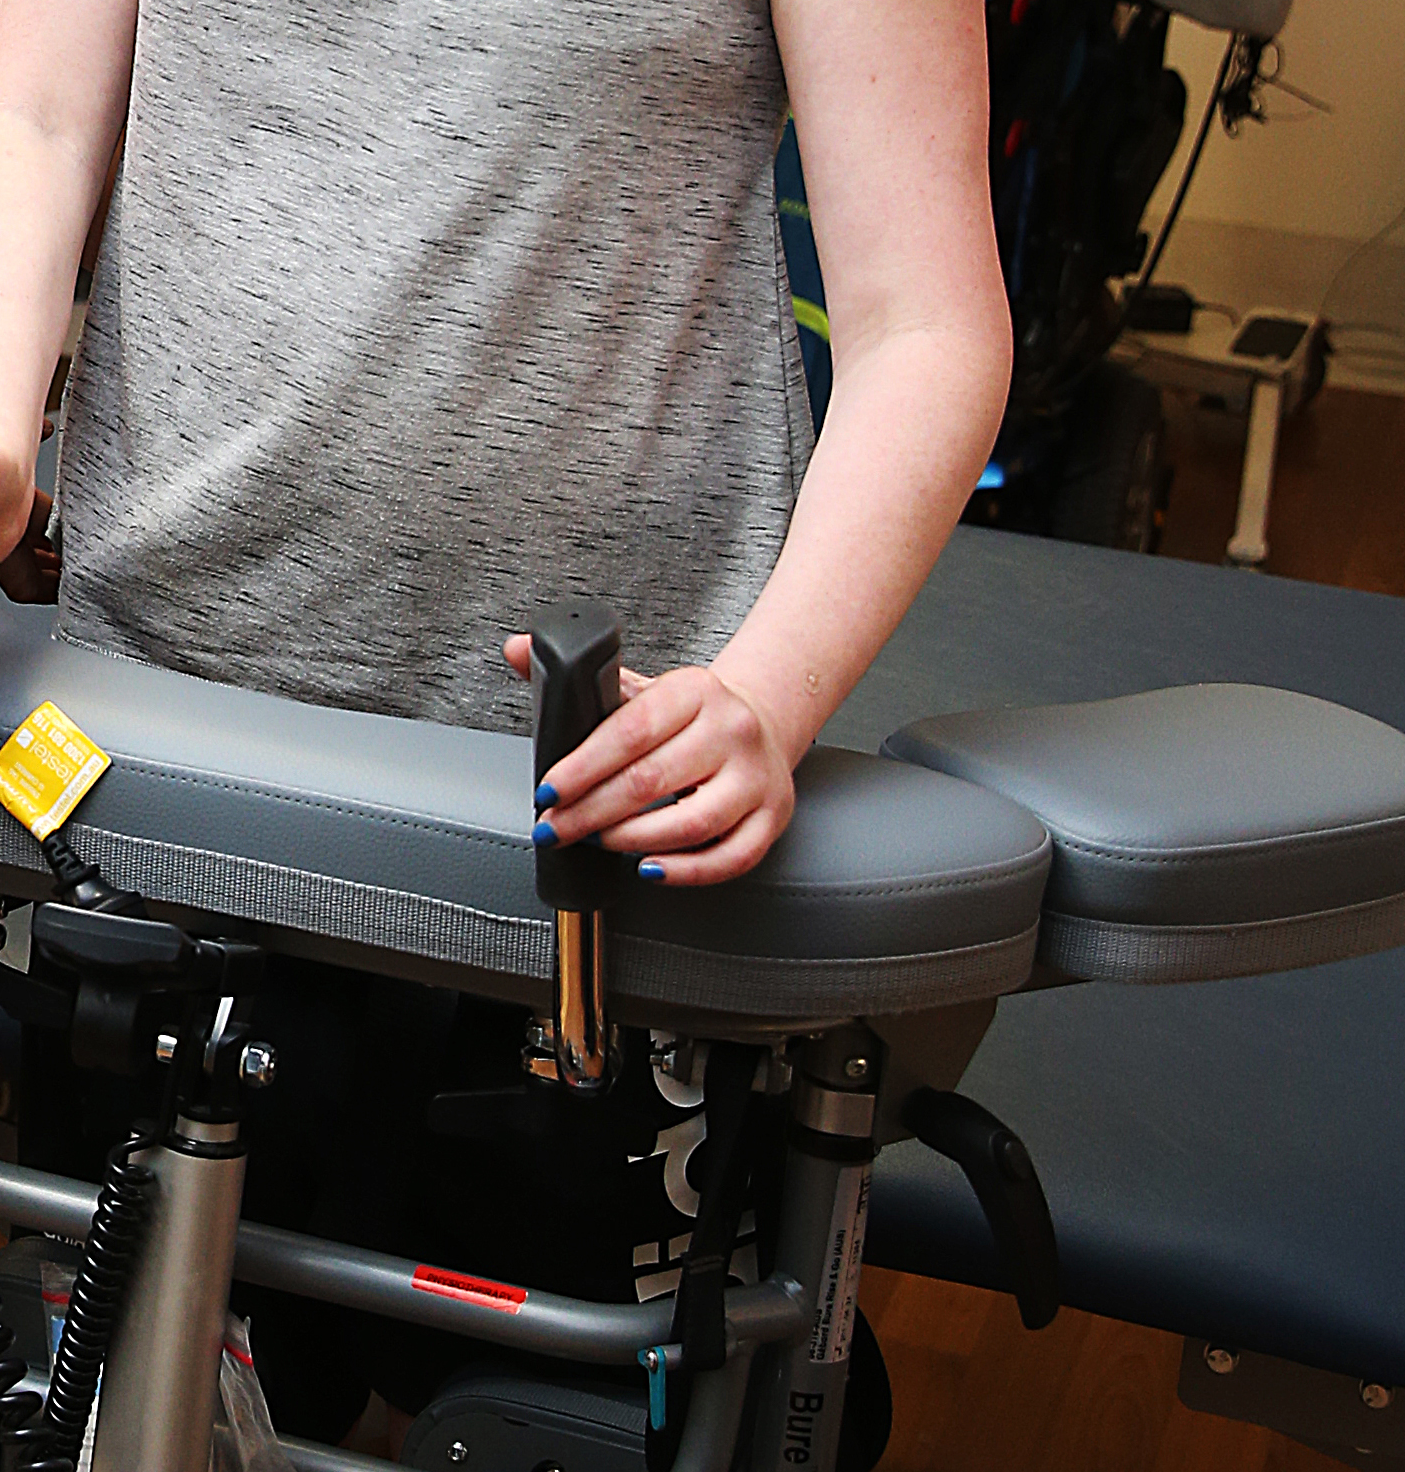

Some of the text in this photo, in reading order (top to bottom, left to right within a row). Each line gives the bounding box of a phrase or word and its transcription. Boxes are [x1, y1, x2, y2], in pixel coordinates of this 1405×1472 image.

[28, 741, 74, 785] testel
[826, 1281, 836, 1301] Rise
[833, 1228, 845, 1255] (AUS)
[783, 1390, 825, 1464] Bure
